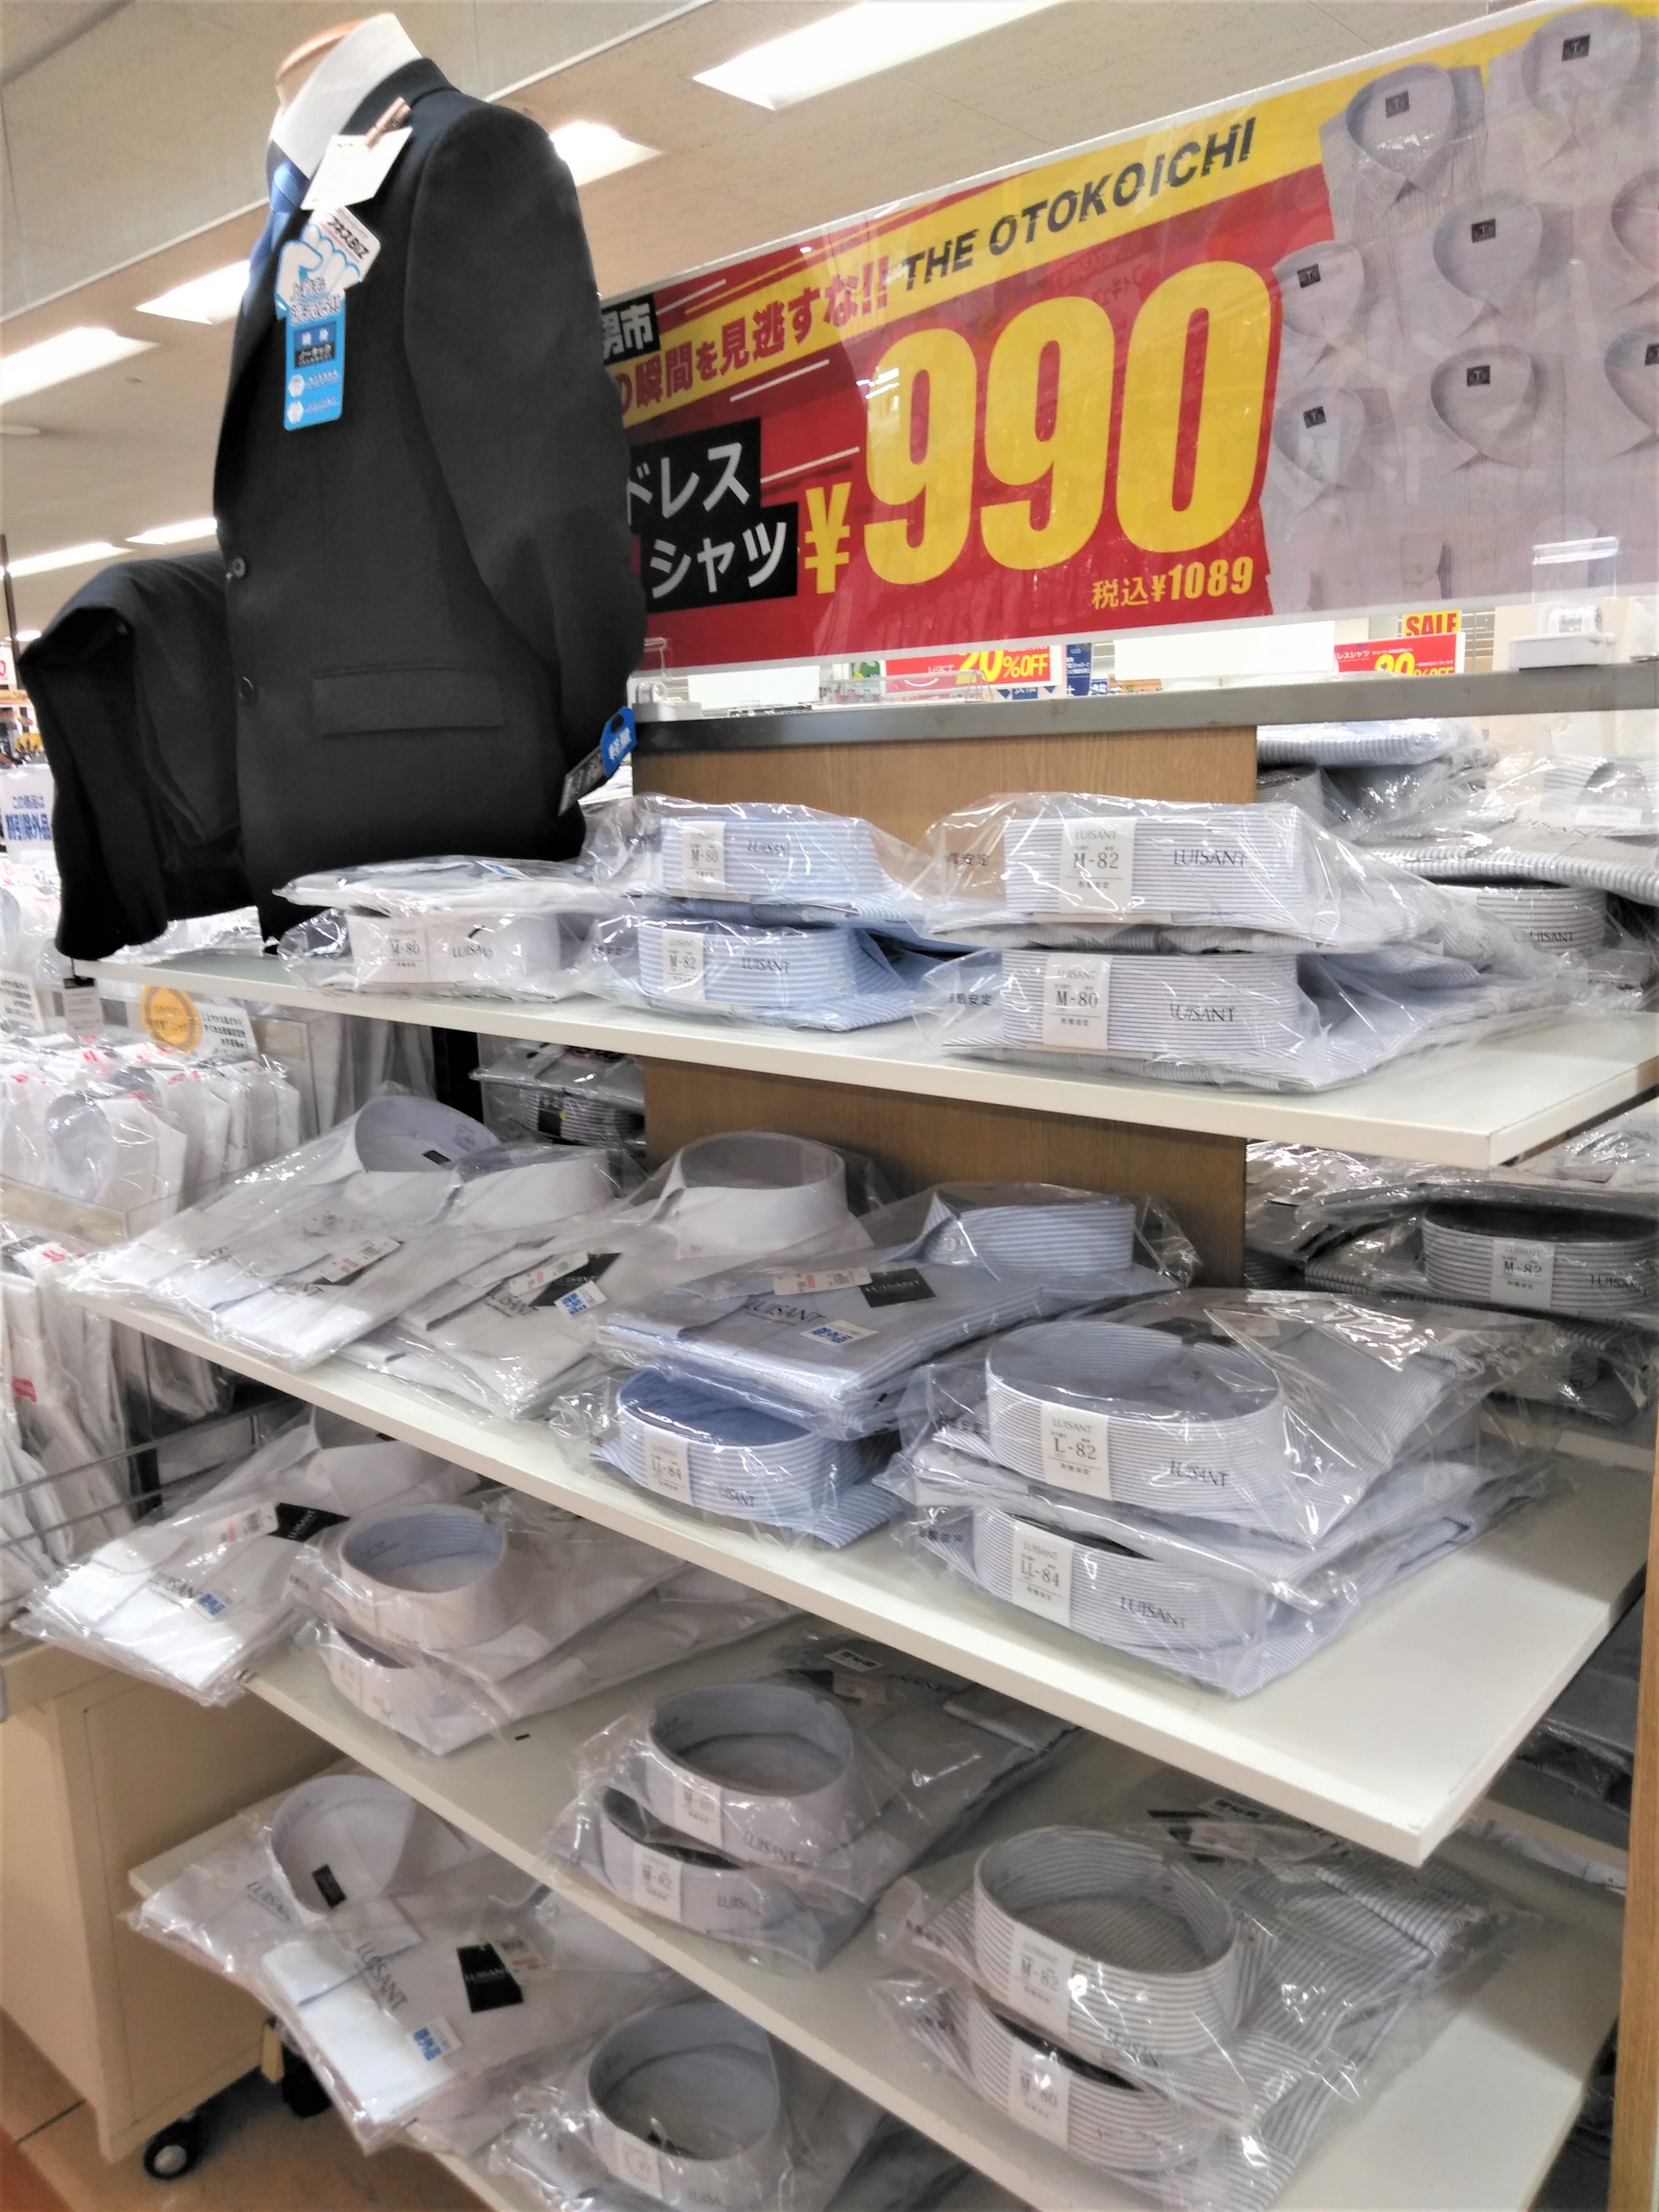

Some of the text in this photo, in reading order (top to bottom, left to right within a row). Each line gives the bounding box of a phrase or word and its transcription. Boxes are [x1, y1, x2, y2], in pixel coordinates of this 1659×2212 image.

[902, 117, 1257, 292] THE OTOKOICHI
[626, 441, 751, 526] ドレス
[650, 522, 787, 599] シャツ
[1091, 556, 1253, 610] 税込¥1089
[1073, 852, 1119, 869] M-82
[1174, 849, 1248, 866] LUISANT
[1056, 990, 1098, 1009] M-80
[1170, 1003, 1237, 1022] LUISANT
[1054, 1437, 1097, 1460] L-82
[1120, 1596, 1186, 1629] LUISANT
